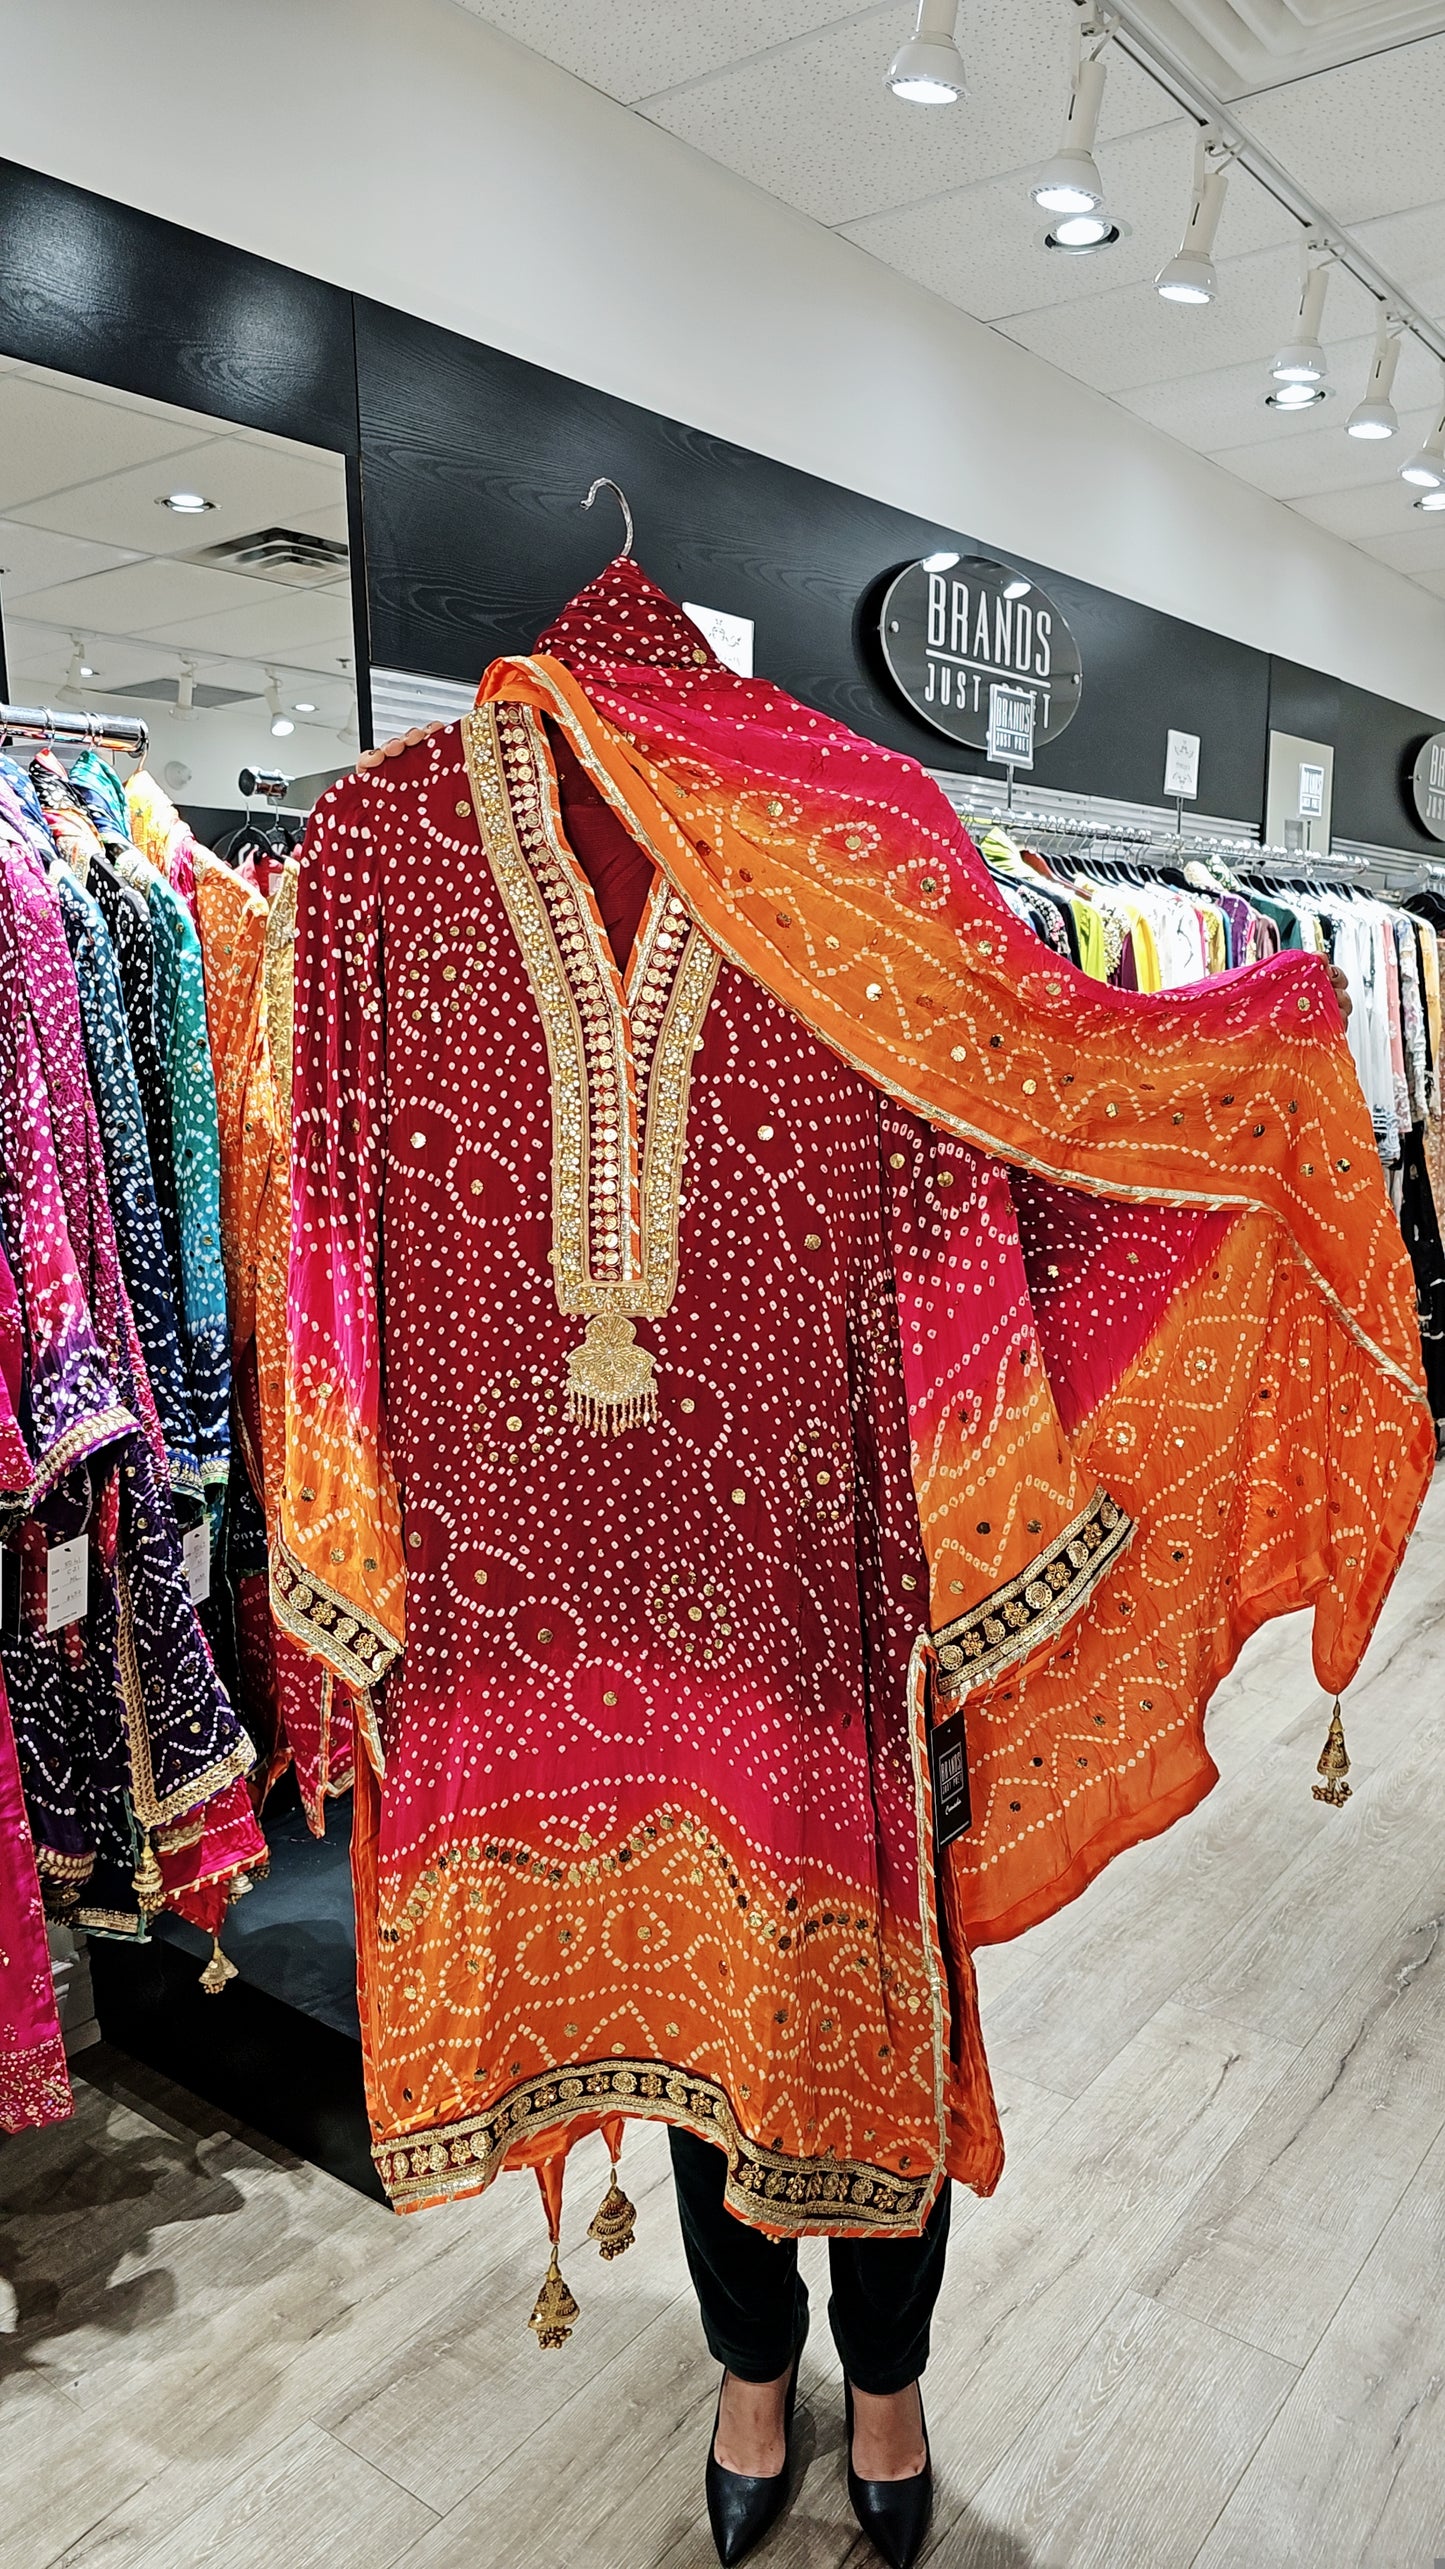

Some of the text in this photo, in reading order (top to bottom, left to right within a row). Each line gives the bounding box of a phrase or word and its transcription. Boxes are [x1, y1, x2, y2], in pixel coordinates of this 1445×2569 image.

[927, 573, 1052, 677] BRANDS
[924, 663, 981, 712] JUST
[996, 697, 1030, 733] BRANDS
[996, 732, 1011, 748] JUST
